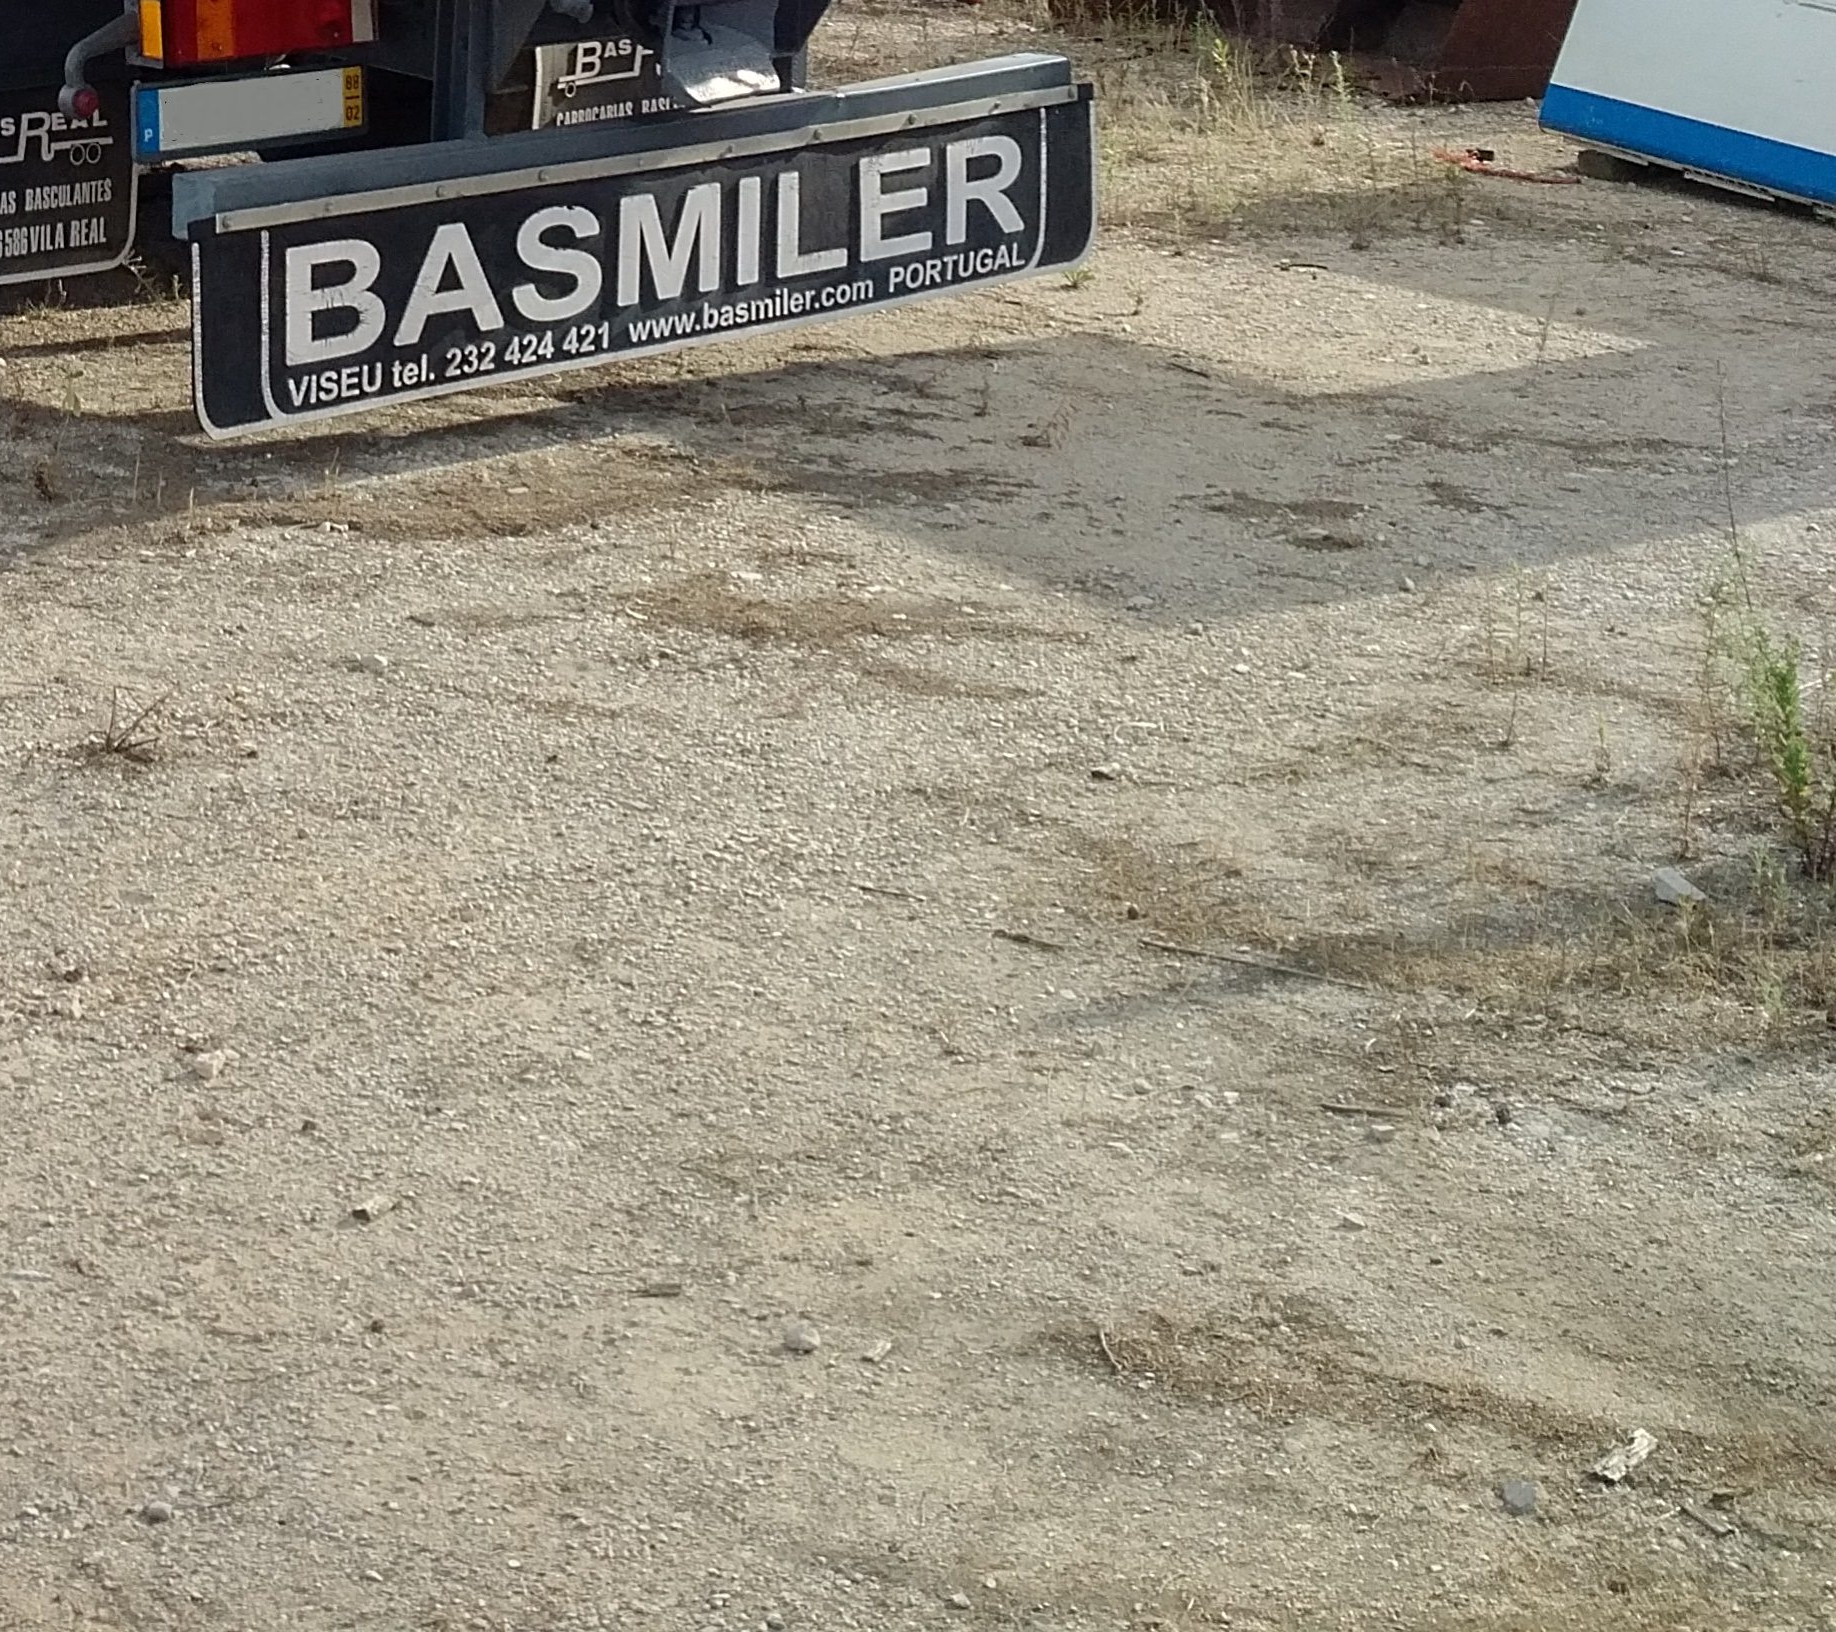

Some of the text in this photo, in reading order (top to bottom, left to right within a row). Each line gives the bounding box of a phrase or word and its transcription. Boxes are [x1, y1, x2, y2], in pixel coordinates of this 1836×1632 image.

[345, 105, 361, 122] 02
[144, 127, 153, 143] P
[24, 178, 113, 212] BASCULANTES
[30, 222, 65, 253] VILA
[69, 216, 107, 247] REAL
[285, 135, 1025, 367] BASMILER
[287, 241, 1026, 408] VISEU tel. 232 424 421 www.basmiler.com PORTUGAL
